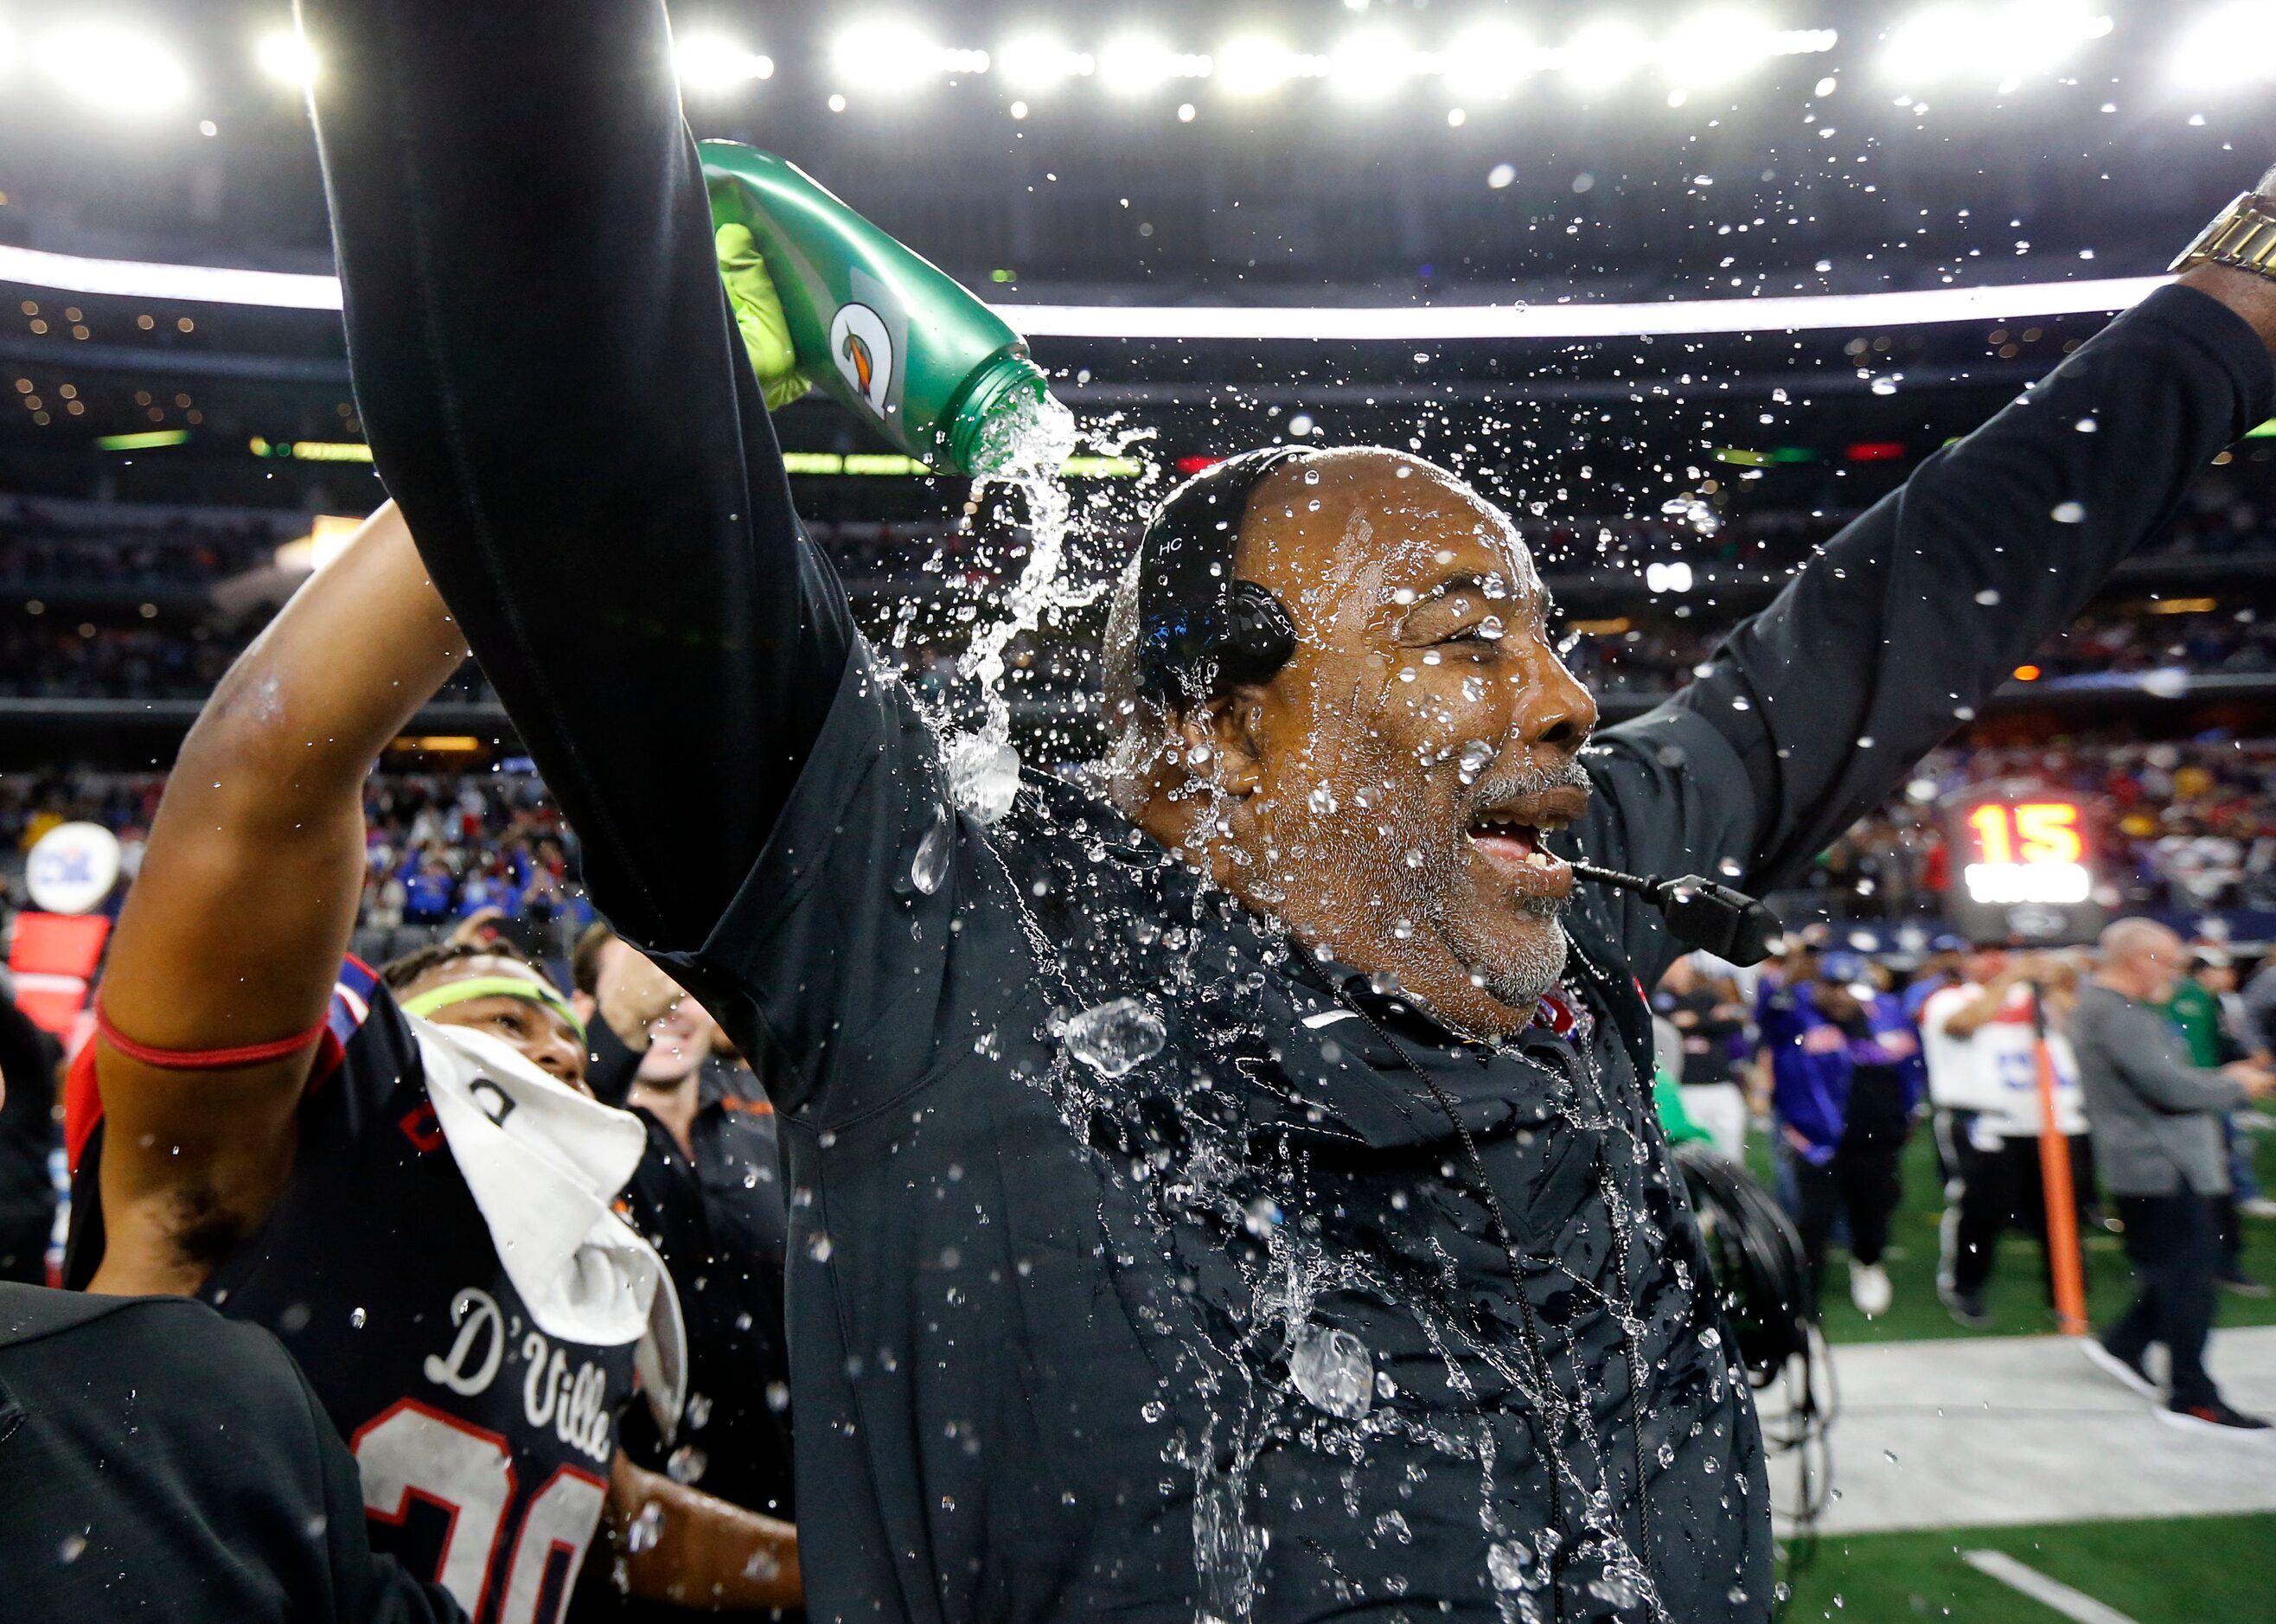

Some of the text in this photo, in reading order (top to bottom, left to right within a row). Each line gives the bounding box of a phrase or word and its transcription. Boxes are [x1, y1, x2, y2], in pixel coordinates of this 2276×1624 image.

[1159, 537, 1183, 556] HC
[1968, 802, 2082, 866] 15
[424, 1285, 612, 1463] D'Ville
